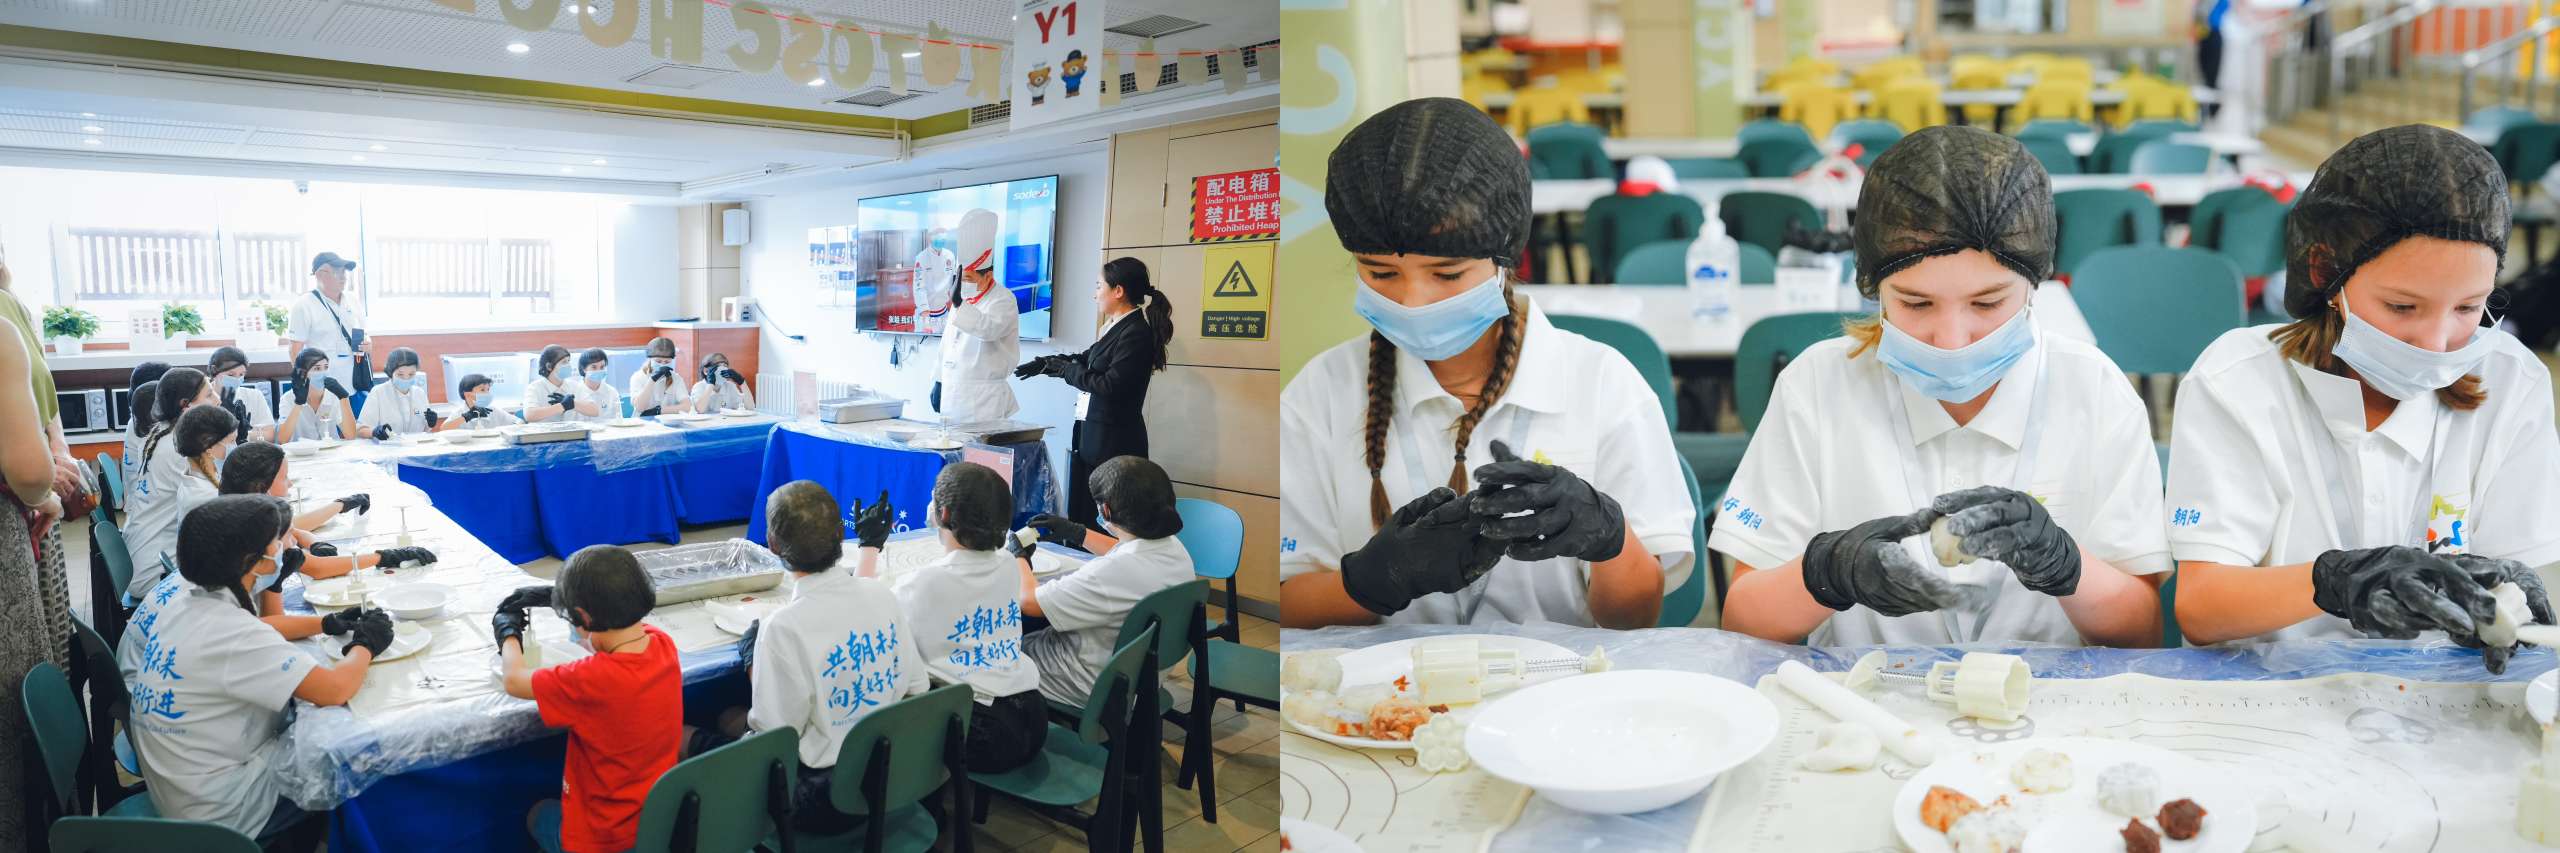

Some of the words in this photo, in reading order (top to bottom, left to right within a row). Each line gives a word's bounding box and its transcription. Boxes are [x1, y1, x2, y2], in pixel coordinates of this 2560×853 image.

[1034, 2, 1076, 44] Y1
[1206, 172, 1280, 197] 配电箱
[1238, 192, 1277, 201] Distribution
[1213, 223, 1255, 233] Prohibited
[1256, 221, 1279, 230] Heap
[1208, 323, 1258, 334] 高压危险
[2173, 506, 2201, 526] 朝阳
[947, 598, 1021, 643] 共朝未来
[950, 636, 1024, 668] 向美好行
